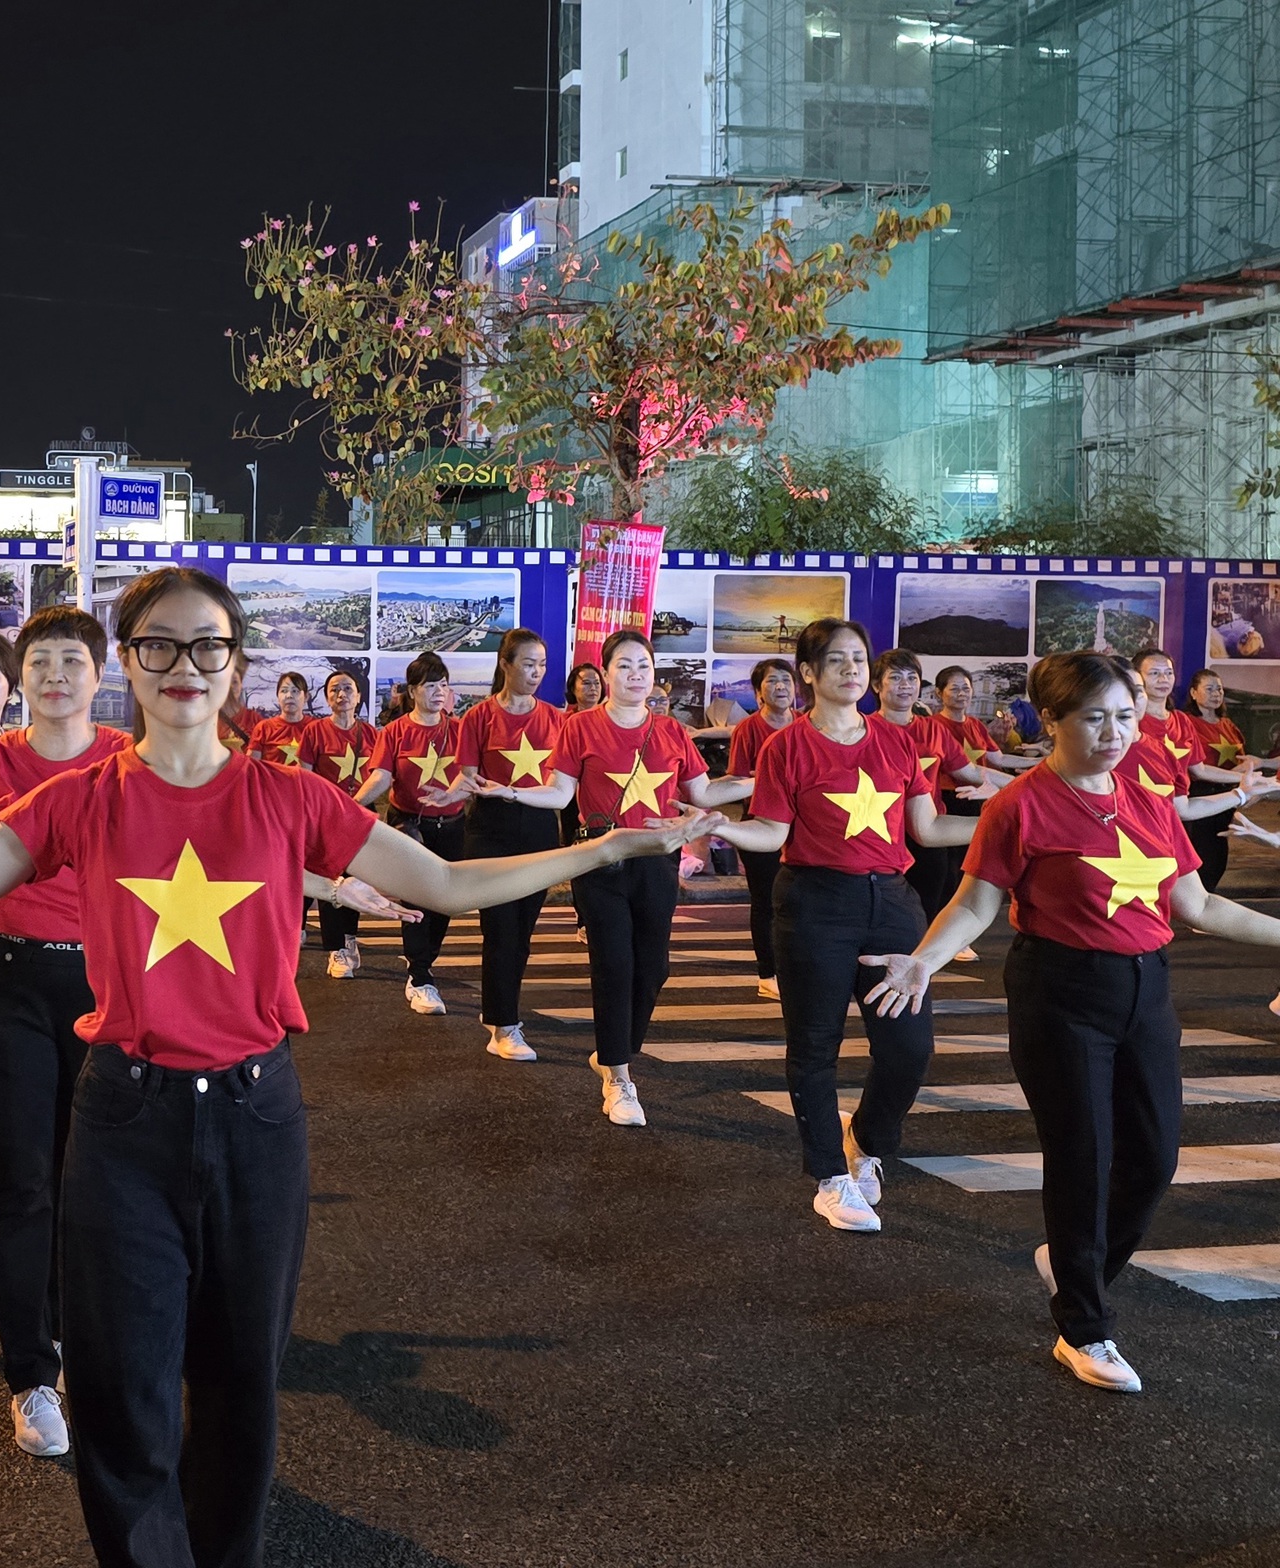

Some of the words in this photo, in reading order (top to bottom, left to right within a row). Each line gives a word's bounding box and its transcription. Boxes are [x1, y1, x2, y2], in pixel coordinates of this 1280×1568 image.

[15, 475, 71, 485] TINGGLE
[122, 482, 155, 494] ĐƯỜNG
[105, 498, 129, 515] BẠCH
